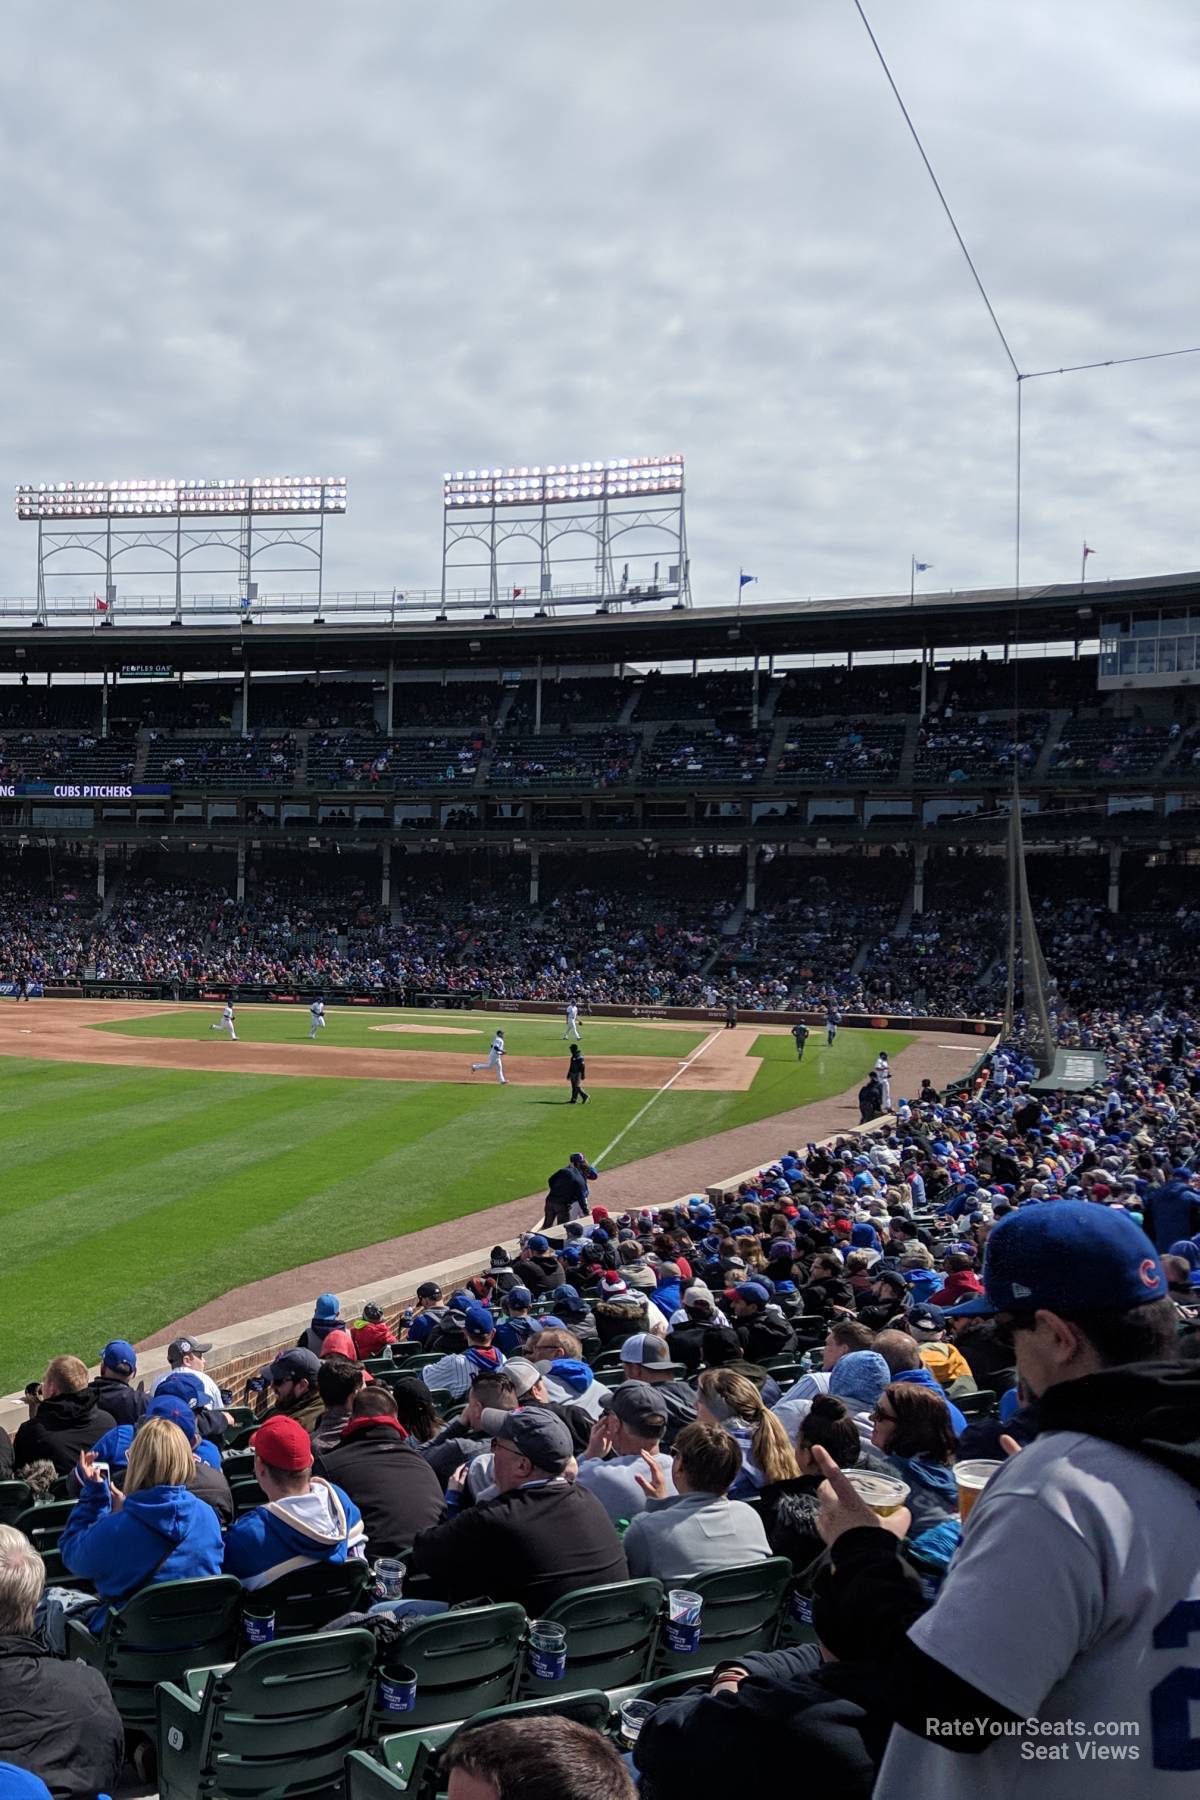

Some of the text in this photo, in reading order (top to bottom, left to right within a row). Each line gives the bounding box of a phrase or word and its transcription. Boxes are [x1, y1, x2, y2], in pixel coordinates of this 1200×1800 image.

[54, 786, 132, 797] CUBS PITCHERS
[1139, 1258, 1161, 1289] C
